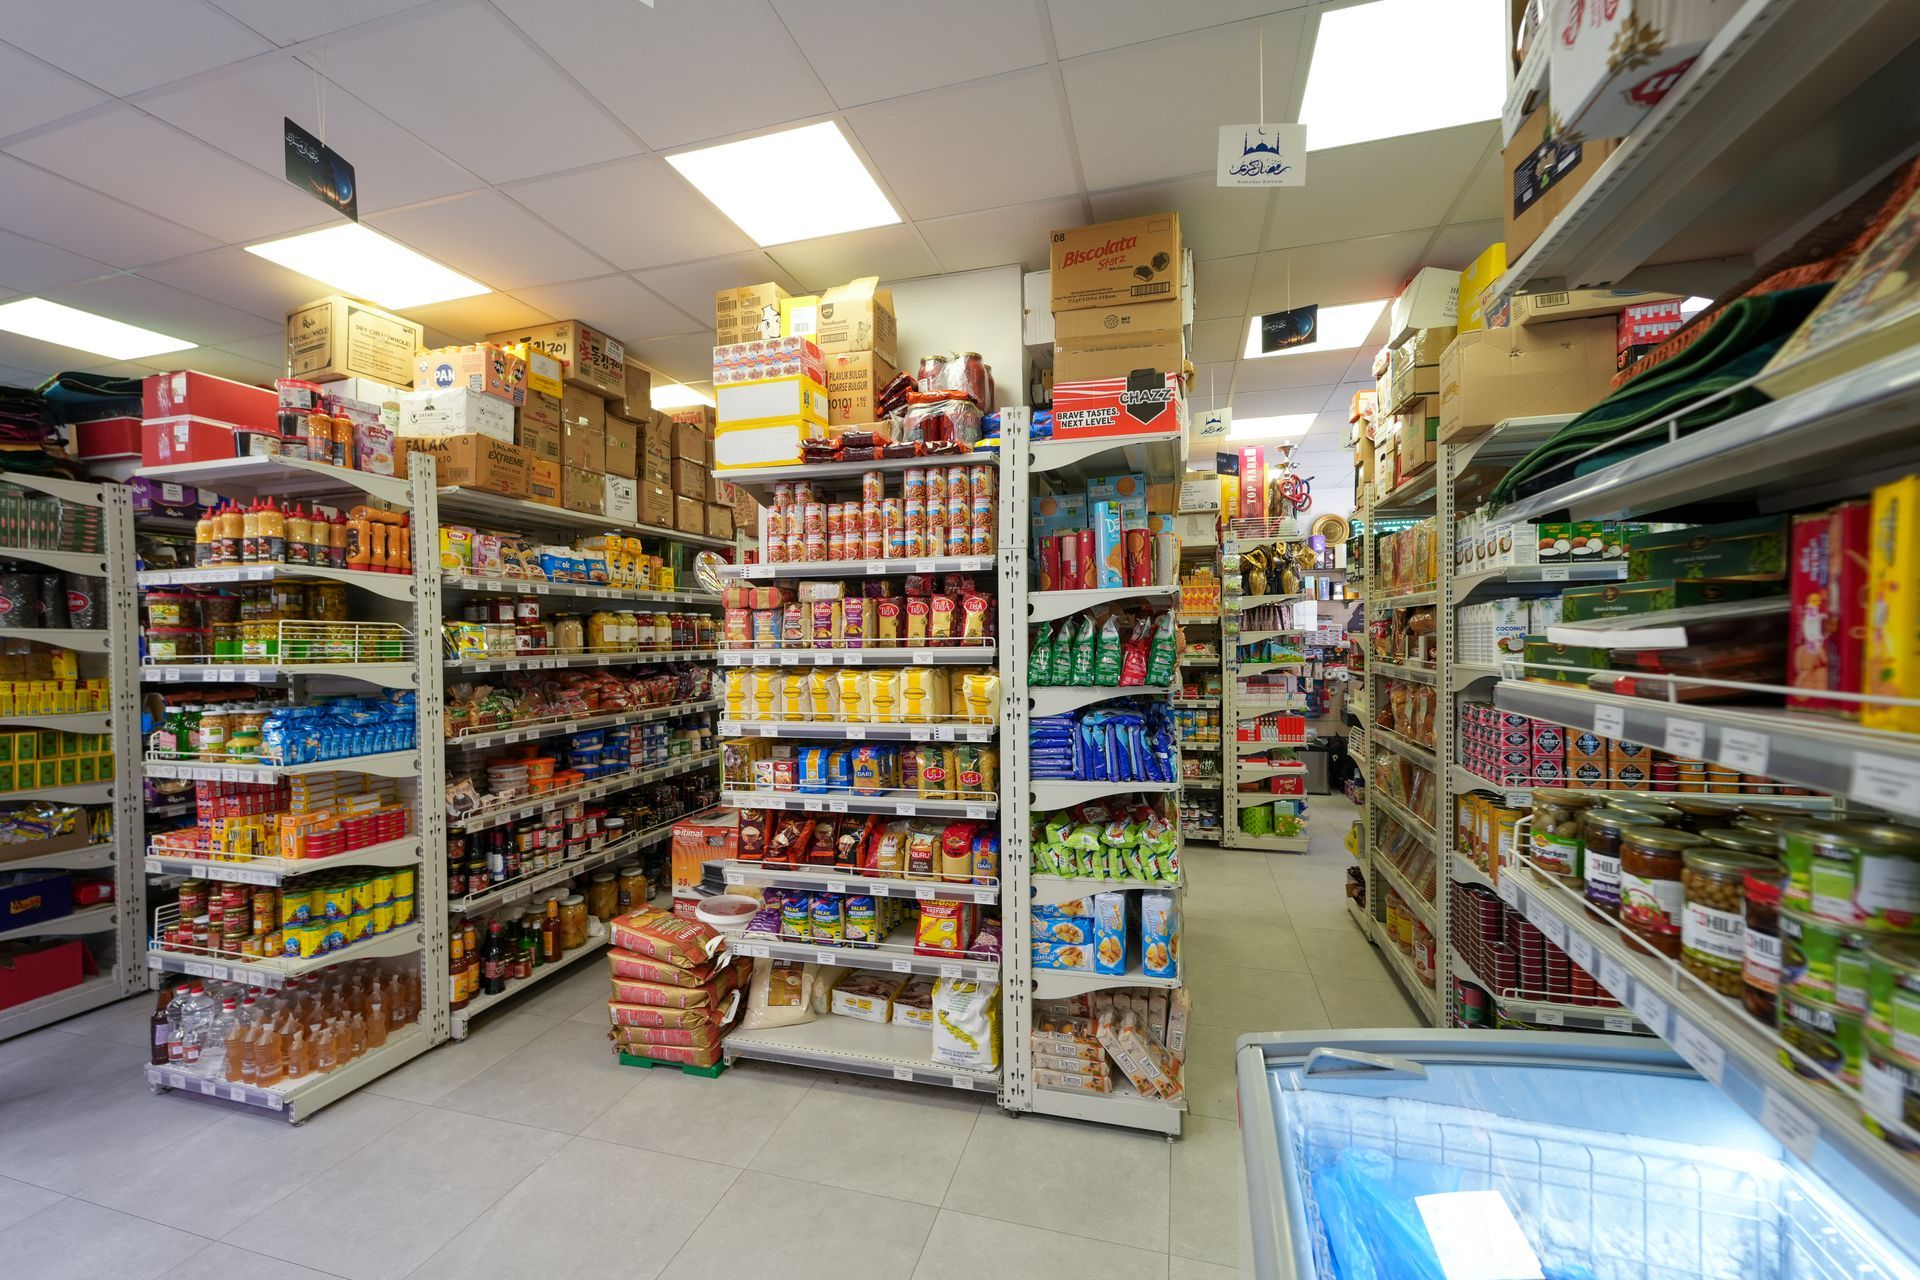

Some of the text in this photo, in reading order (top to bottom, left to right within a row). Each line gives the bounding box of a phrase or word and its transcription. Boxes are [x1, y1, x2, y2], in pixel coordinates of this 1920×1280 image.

[1053, 233, 1065, 243] 08
[1062, 235, 1138, 269] Biscolata
[849, 369, 868, 379] BULGUR
[848, 381, 868, 391] BULGUR
[1119, 388, 1173, 405] CHAZZ
[1056, 408, 1120, 421] BRAVE TASTES.
[1061, 416, 1115, 428] NEXT LEVEL.
[405, 439, 449, 452] FALAK
[488, 450, 525, 467] EXTREME
[1246, 453, 1257, 505] TOP MARK
[1538, 737, 1560, 746] Exeter
[1577, 739, 1600, 747] Exeter
[1537, 768, 1559, 776] Exeter
[1620, 771, 1643, 779] Exeter
